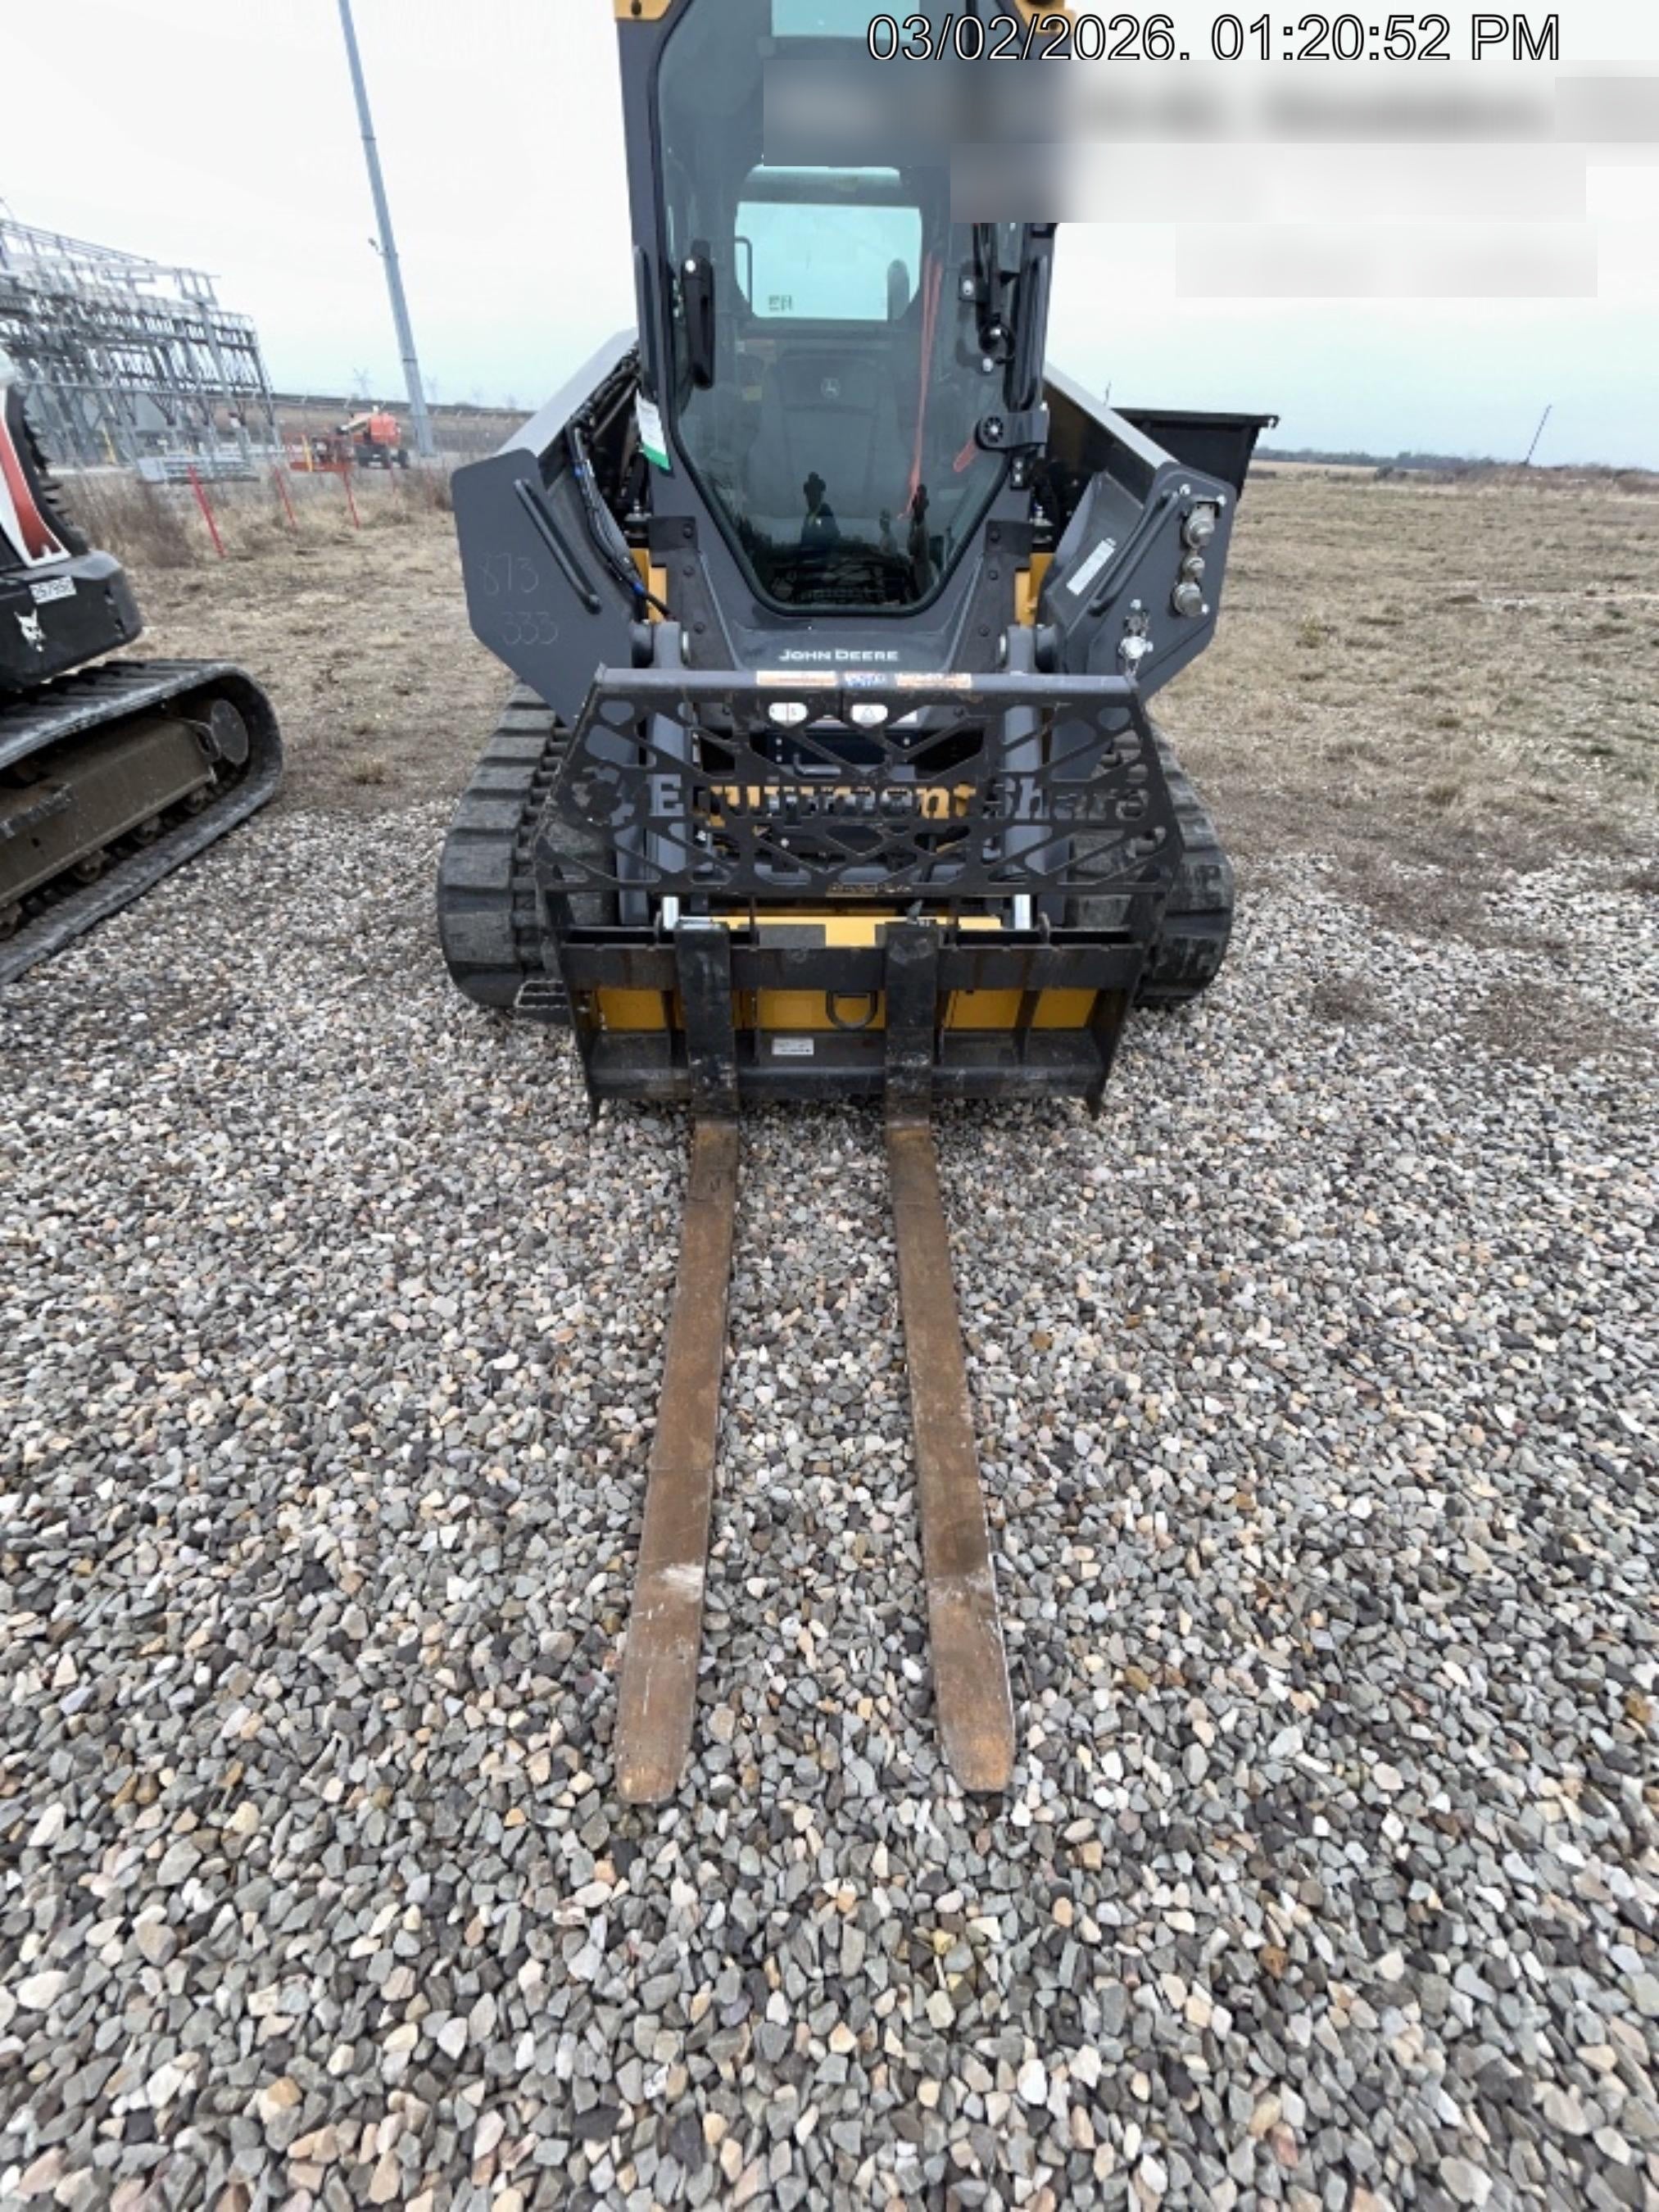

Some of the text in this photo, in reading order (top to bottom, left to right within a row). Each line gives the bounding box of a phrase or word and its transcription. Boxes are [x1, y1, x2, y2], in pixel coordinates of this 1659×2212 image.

[501, 611, 559, 645] 333
[779, 648, 899, 663] JOHN DEERE
